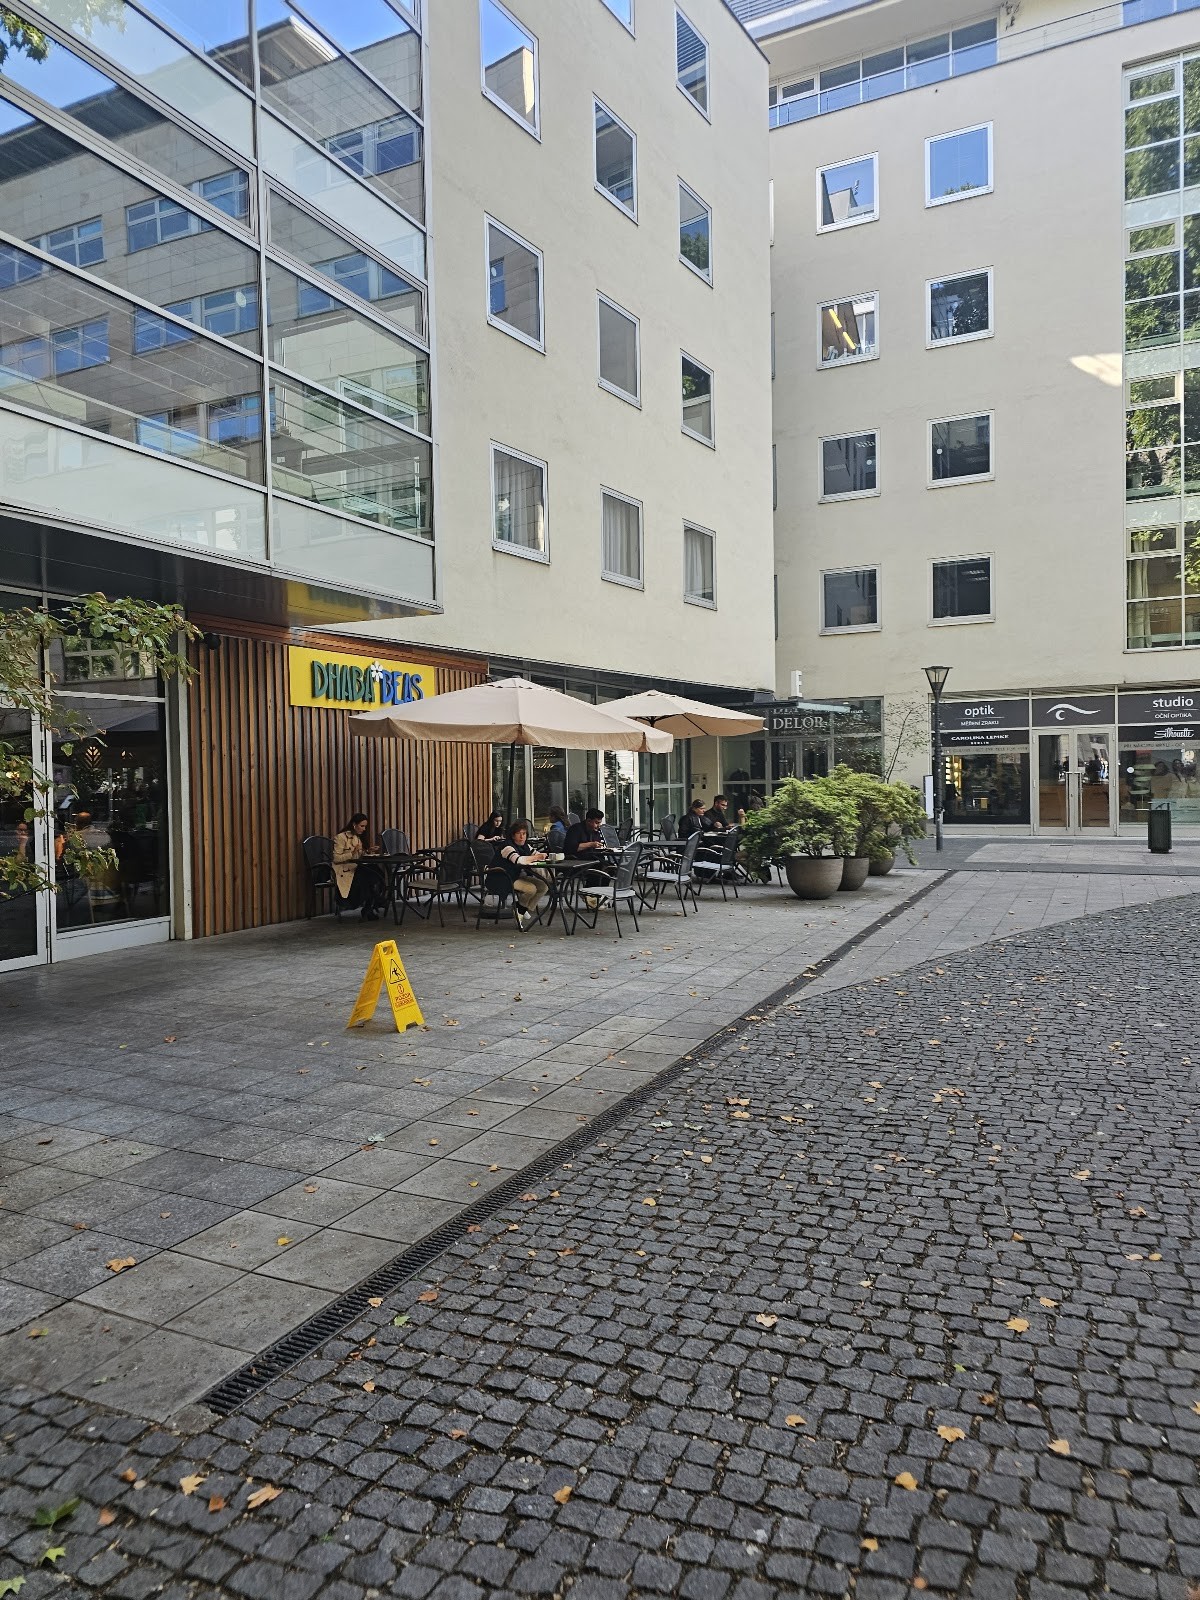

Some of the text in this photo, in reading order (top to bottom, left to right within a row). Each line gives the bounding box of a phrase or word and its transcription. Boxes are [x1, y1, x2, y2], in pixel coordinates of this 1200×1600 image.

[312, 661, 424, 705] DHABA BEAS
[1152, 696, 1194, 708] studio
[964, 704, 995, 718] optik
[1153, 727, 1195, 739] Silhouette
